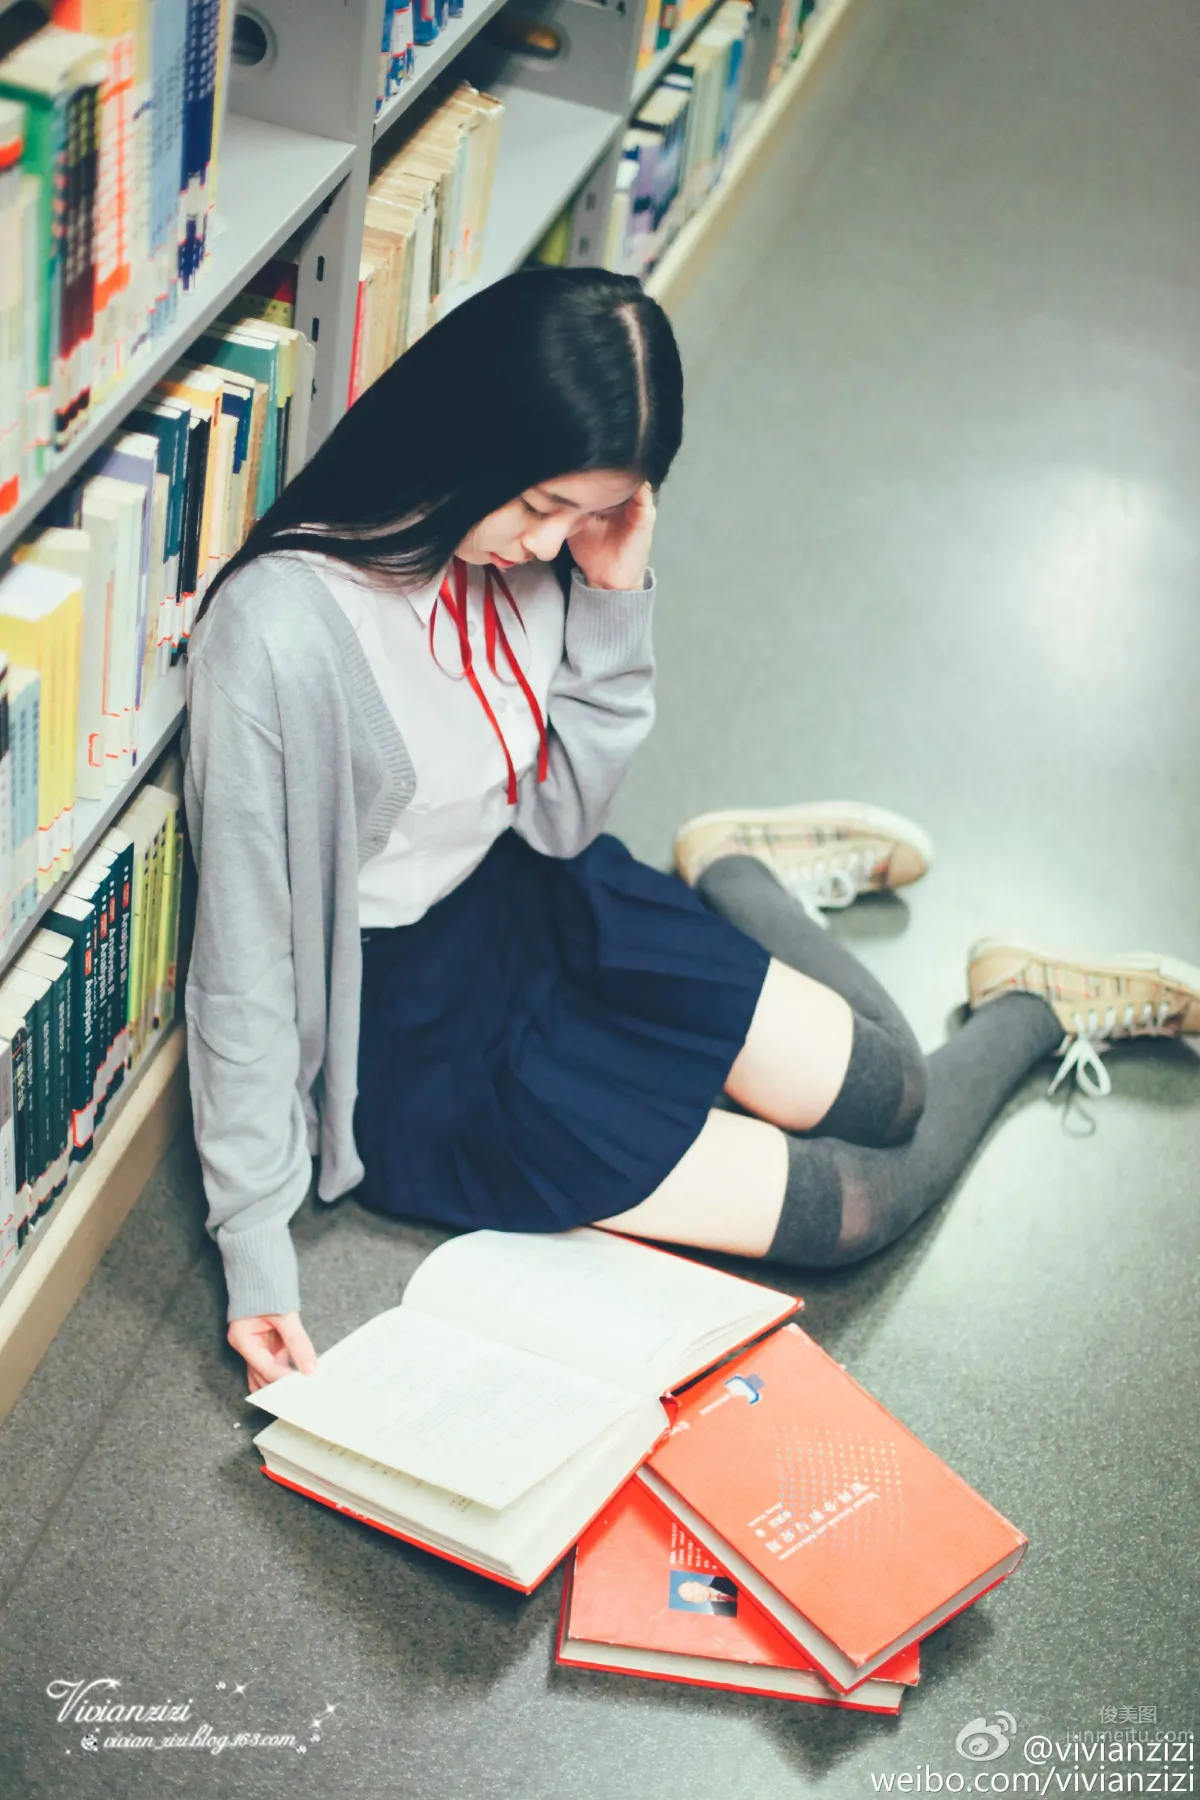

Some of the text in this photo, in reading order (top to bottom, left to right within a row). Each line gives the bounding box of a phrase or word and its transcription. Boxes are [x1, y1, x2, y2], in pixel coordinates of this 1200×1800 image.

[119, 912, 129, 969] Analysis
[98, 942, 108, 1000] Analysis
[83, 979, 94, 1036] Analysis
